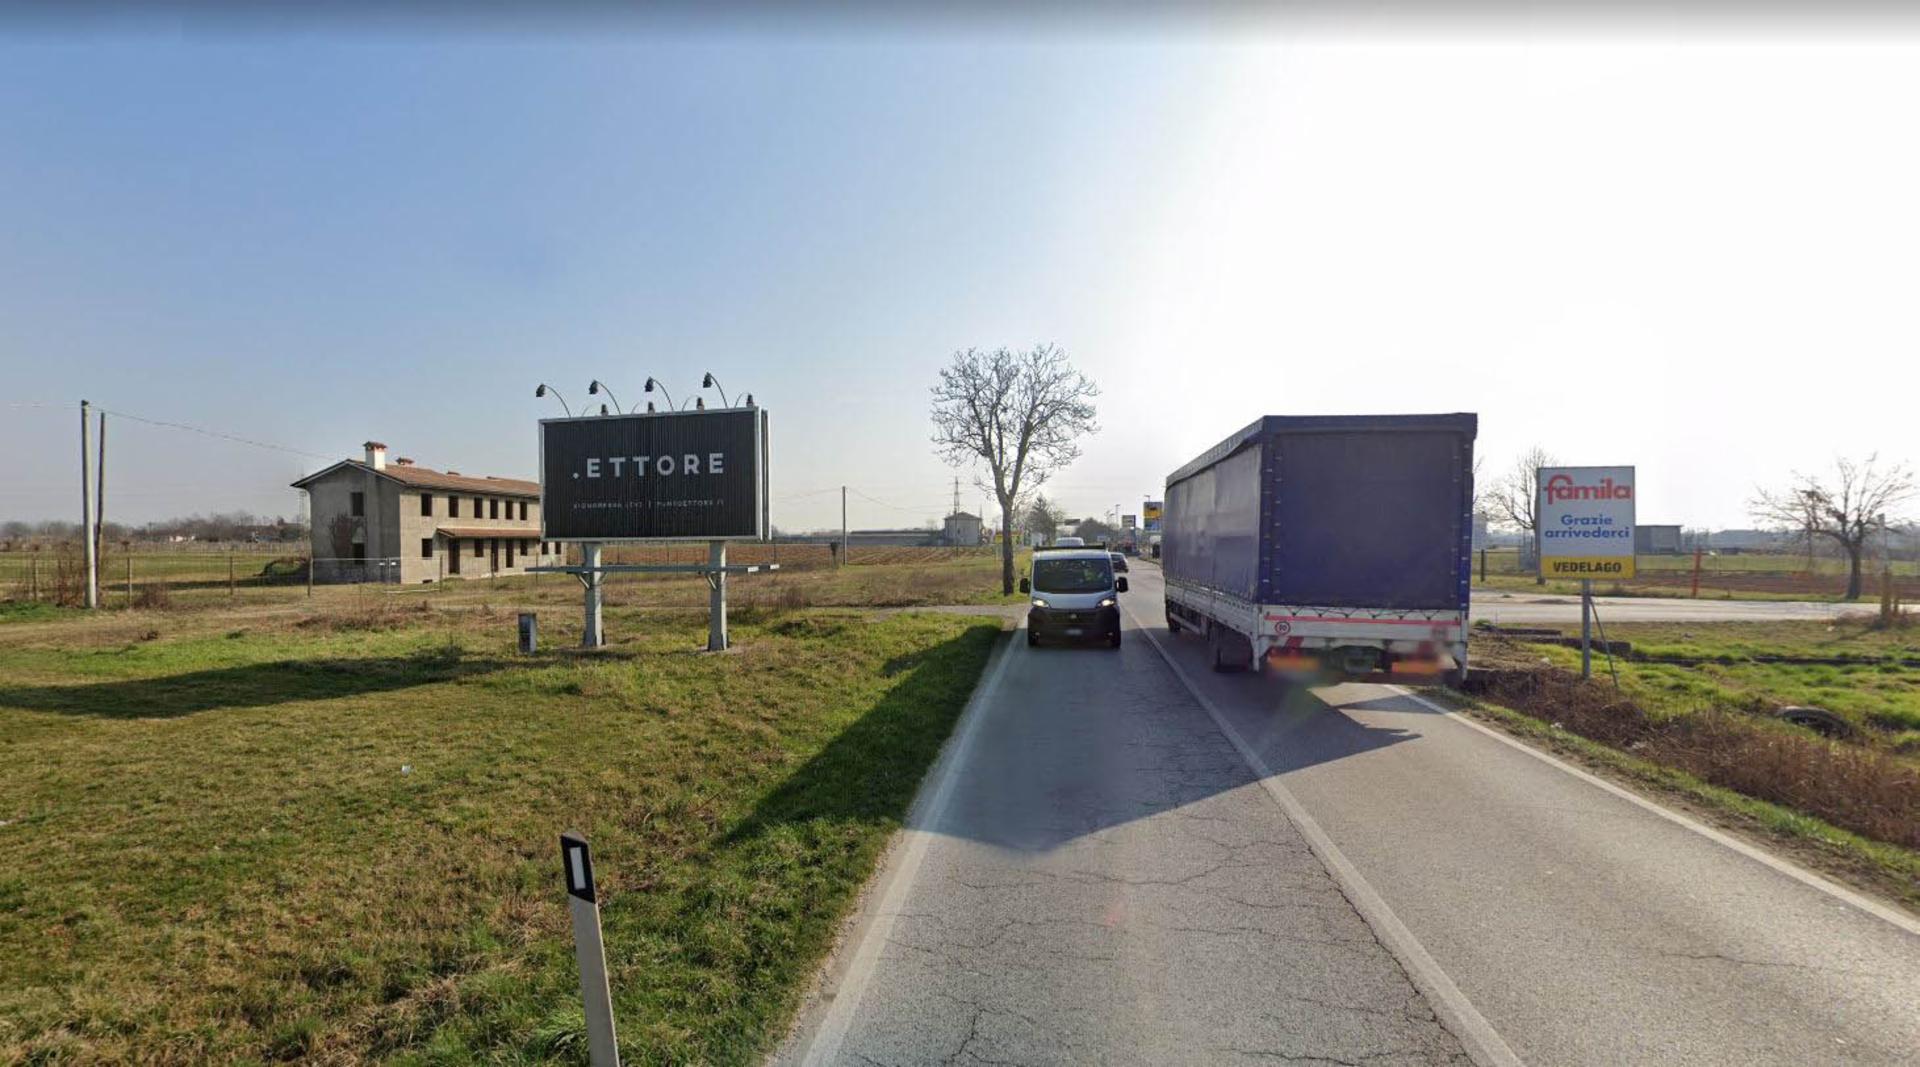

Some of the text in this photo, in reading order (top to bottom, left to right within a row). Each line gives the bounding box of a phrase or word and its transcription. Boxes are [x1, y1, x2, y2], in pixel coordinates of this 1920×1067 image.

[1544, 474, 1632, 505] famila
[1561, 514, 1613, 525] Grazie
[1545, 527, 1630, 538] arrivederci
[1553, 562, 1622, 573] VEDELAGO
